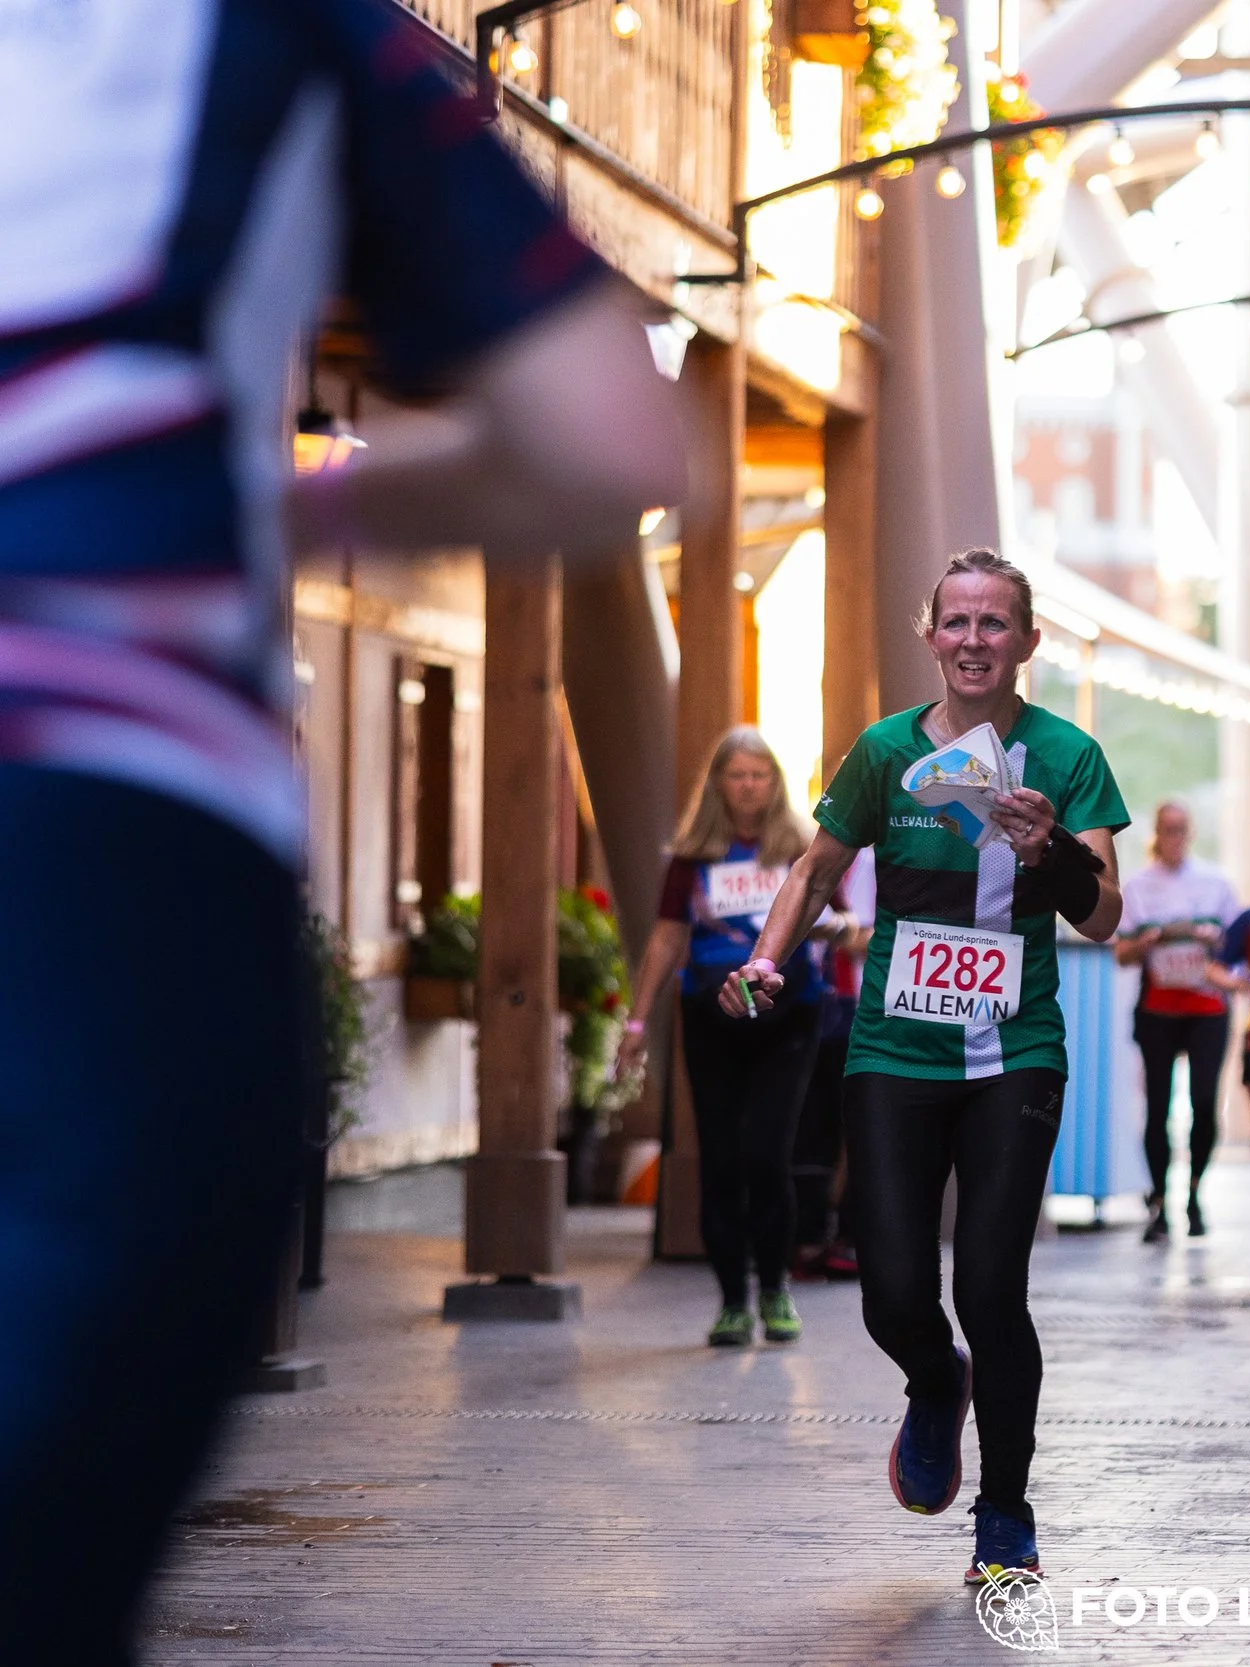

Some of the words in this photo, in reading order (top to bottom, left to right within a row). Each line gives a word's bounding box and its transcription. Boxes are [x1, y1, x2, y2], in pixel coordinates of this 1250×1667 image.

[919, 930, 942, 940] Gröna
[944, 932, 998, 946] Lund-sprinten
[908, 941, 1006, 995] 1282
[894, 990, 1009, 1023] ALLEMAN
